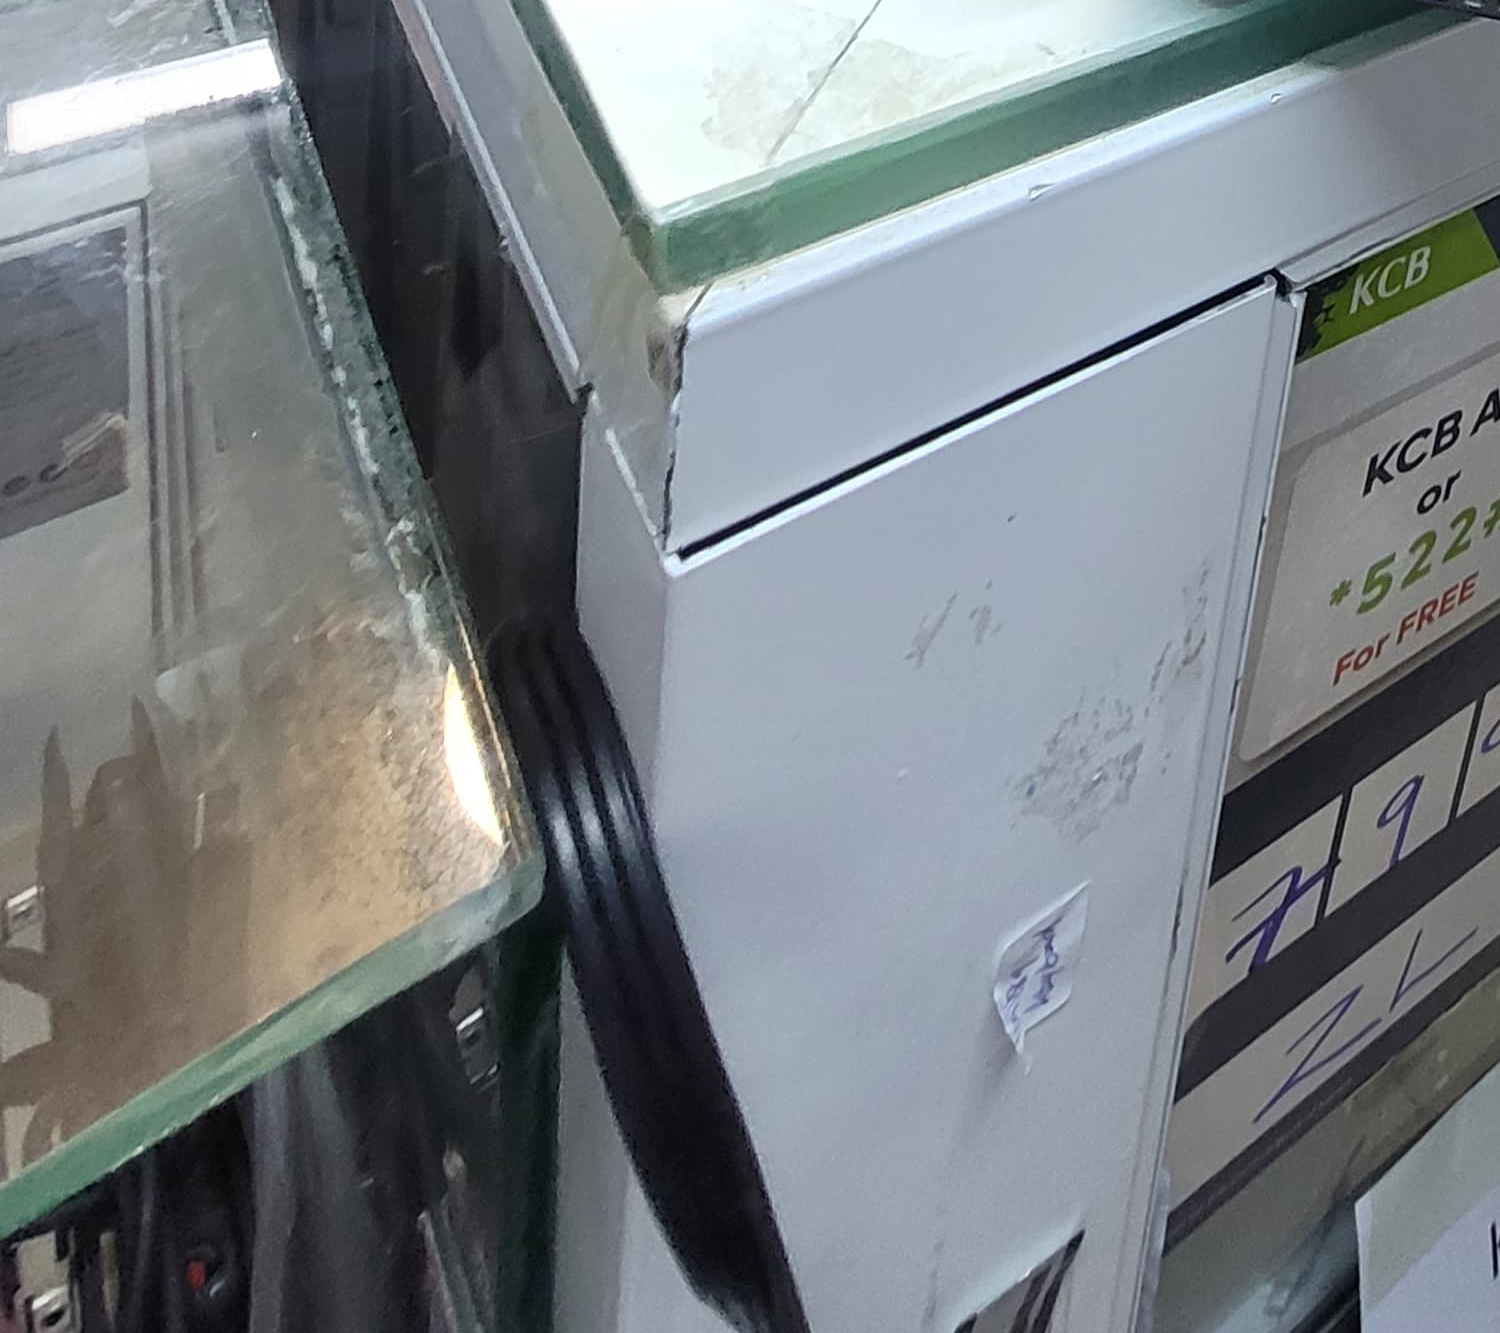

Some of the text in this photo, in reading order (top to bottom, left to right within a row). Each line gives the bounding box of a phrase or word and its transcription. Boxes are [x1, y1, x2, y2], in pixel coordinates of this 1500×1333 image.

[1348, 245, 1433, 315] KCB
[1362, 409, 1463, 498] KCB
[1416, 470, 1461, 516] or
[1332, 570, 1480, 686] For FREE
[1377, 775, 1426, 871] 9
